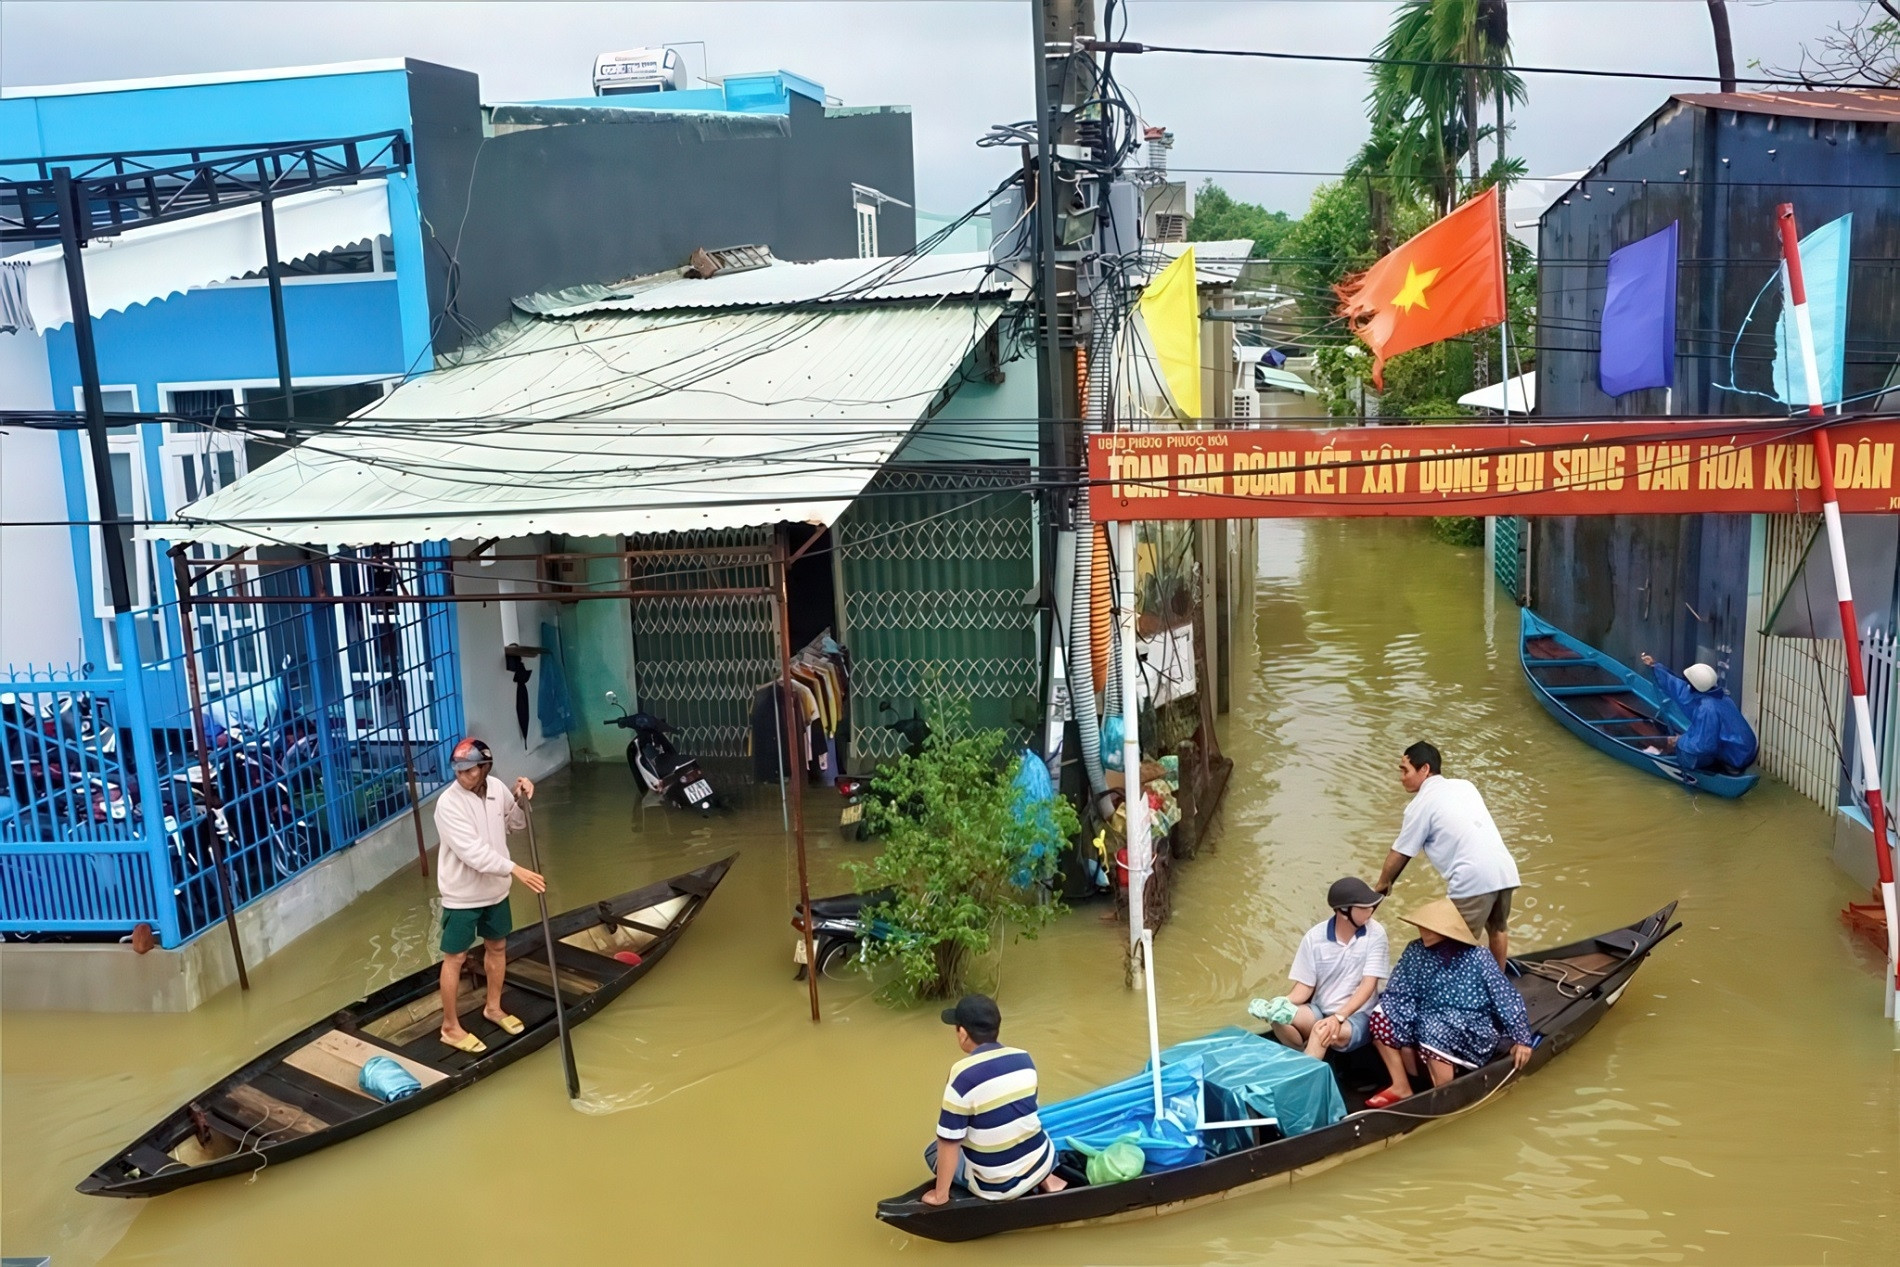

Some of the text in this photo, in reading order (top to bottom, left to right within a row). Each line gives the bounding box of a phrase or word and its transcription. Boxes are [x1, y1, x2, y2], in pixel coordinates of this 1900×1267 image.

[1178, 446, 1225, 497] DÂN
[1304, 437, 1352, 494] KẾT
[1361, 443, 1411, 494] XÂY
[1419, 443, 1490, 499] DỰNG
[1699, 435, 1754, 490] HÓA
[1764, 443, 1823, 490] KHU
[1834, 437, 1895, 489] DÂN
